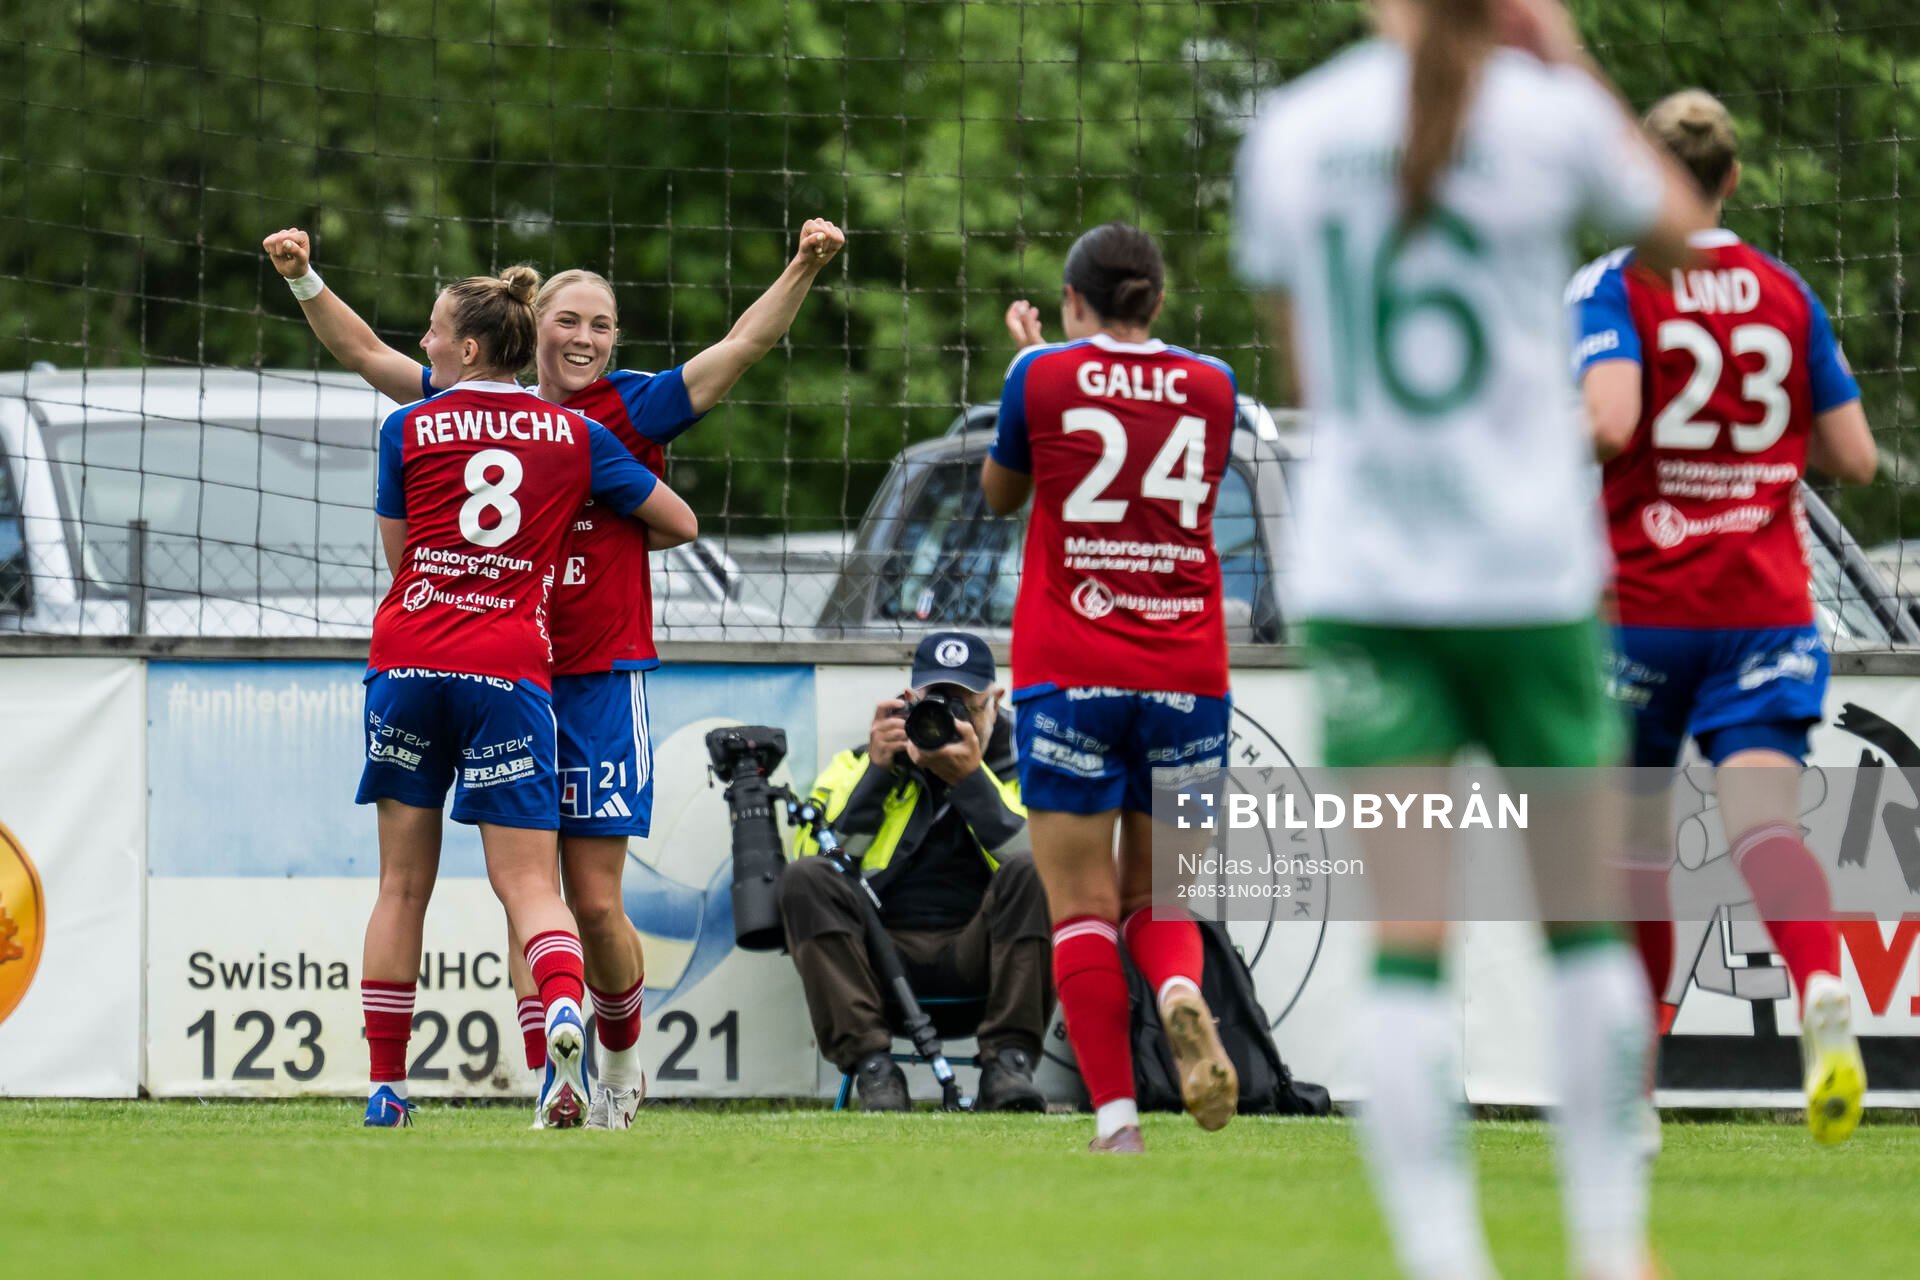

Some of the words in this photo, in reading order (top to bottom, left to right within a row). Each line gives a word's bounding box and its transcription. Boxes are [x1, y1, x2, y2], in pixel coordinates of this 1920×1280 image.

[1671, 266, 1760, 314] LIND
[1321, 205, 1488, 418] 16
[1077, 361, 1188, 404] GALIC
[1652, 319, 1793, 452] 23
[415, 410, 575, 446] REWUCHA
[1061, 407, 1212, 529] 24
[459, 449, 523, 547] 8
[1065, 536, 1206, 563] Motorcentrum
[479, 566, 500, 580] AB
[433, 590, 516, 609] MUSKHUSET
[464, 756, 534, 781] PEAB
[599, 761, 626, 788] 21
[187, 951, 349, 990] Swisha
[186, 1009, 326, 1081] 123
[657, 1009, 740, 1081] 21
